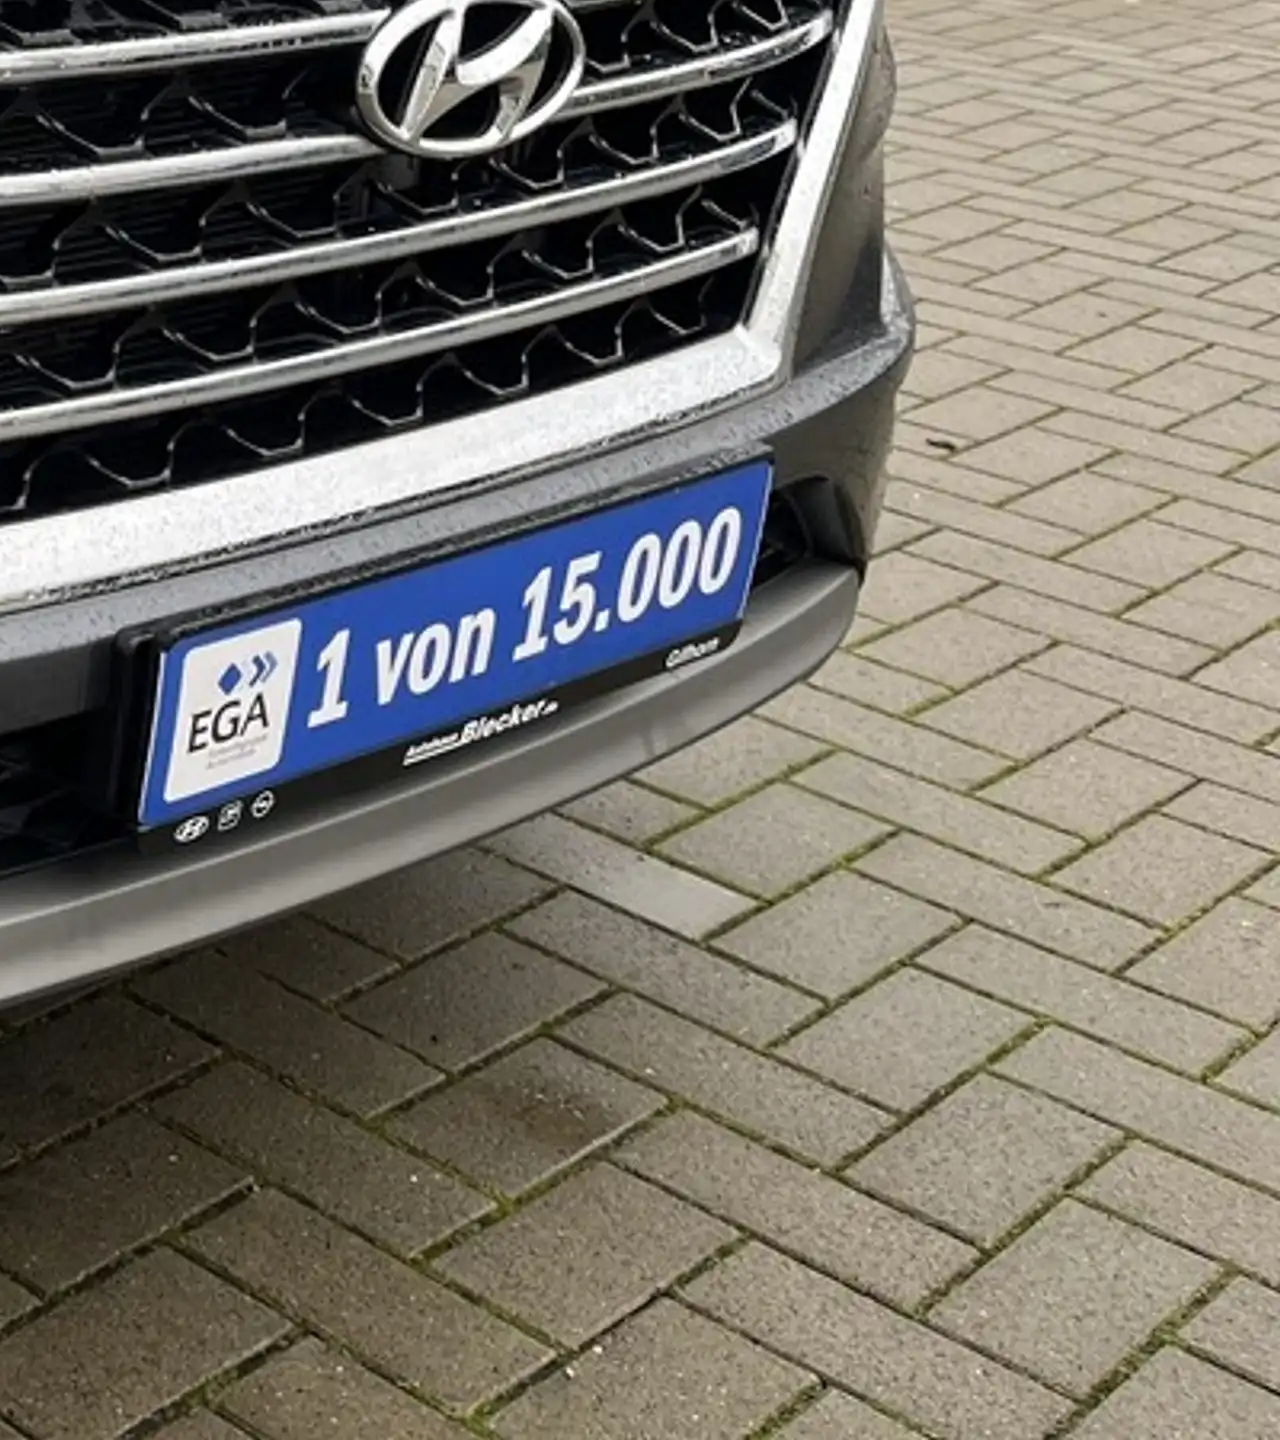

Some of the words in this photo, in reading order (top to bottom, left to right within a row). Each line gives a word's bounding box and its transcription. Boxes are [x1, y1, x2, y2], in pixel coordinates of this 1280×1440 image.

[307, 628, 351, 728] 1
[376, 606, 497, 706] von
[512, 506, 742, 663] 15.000
[187, 692, 270, 754] EGA
